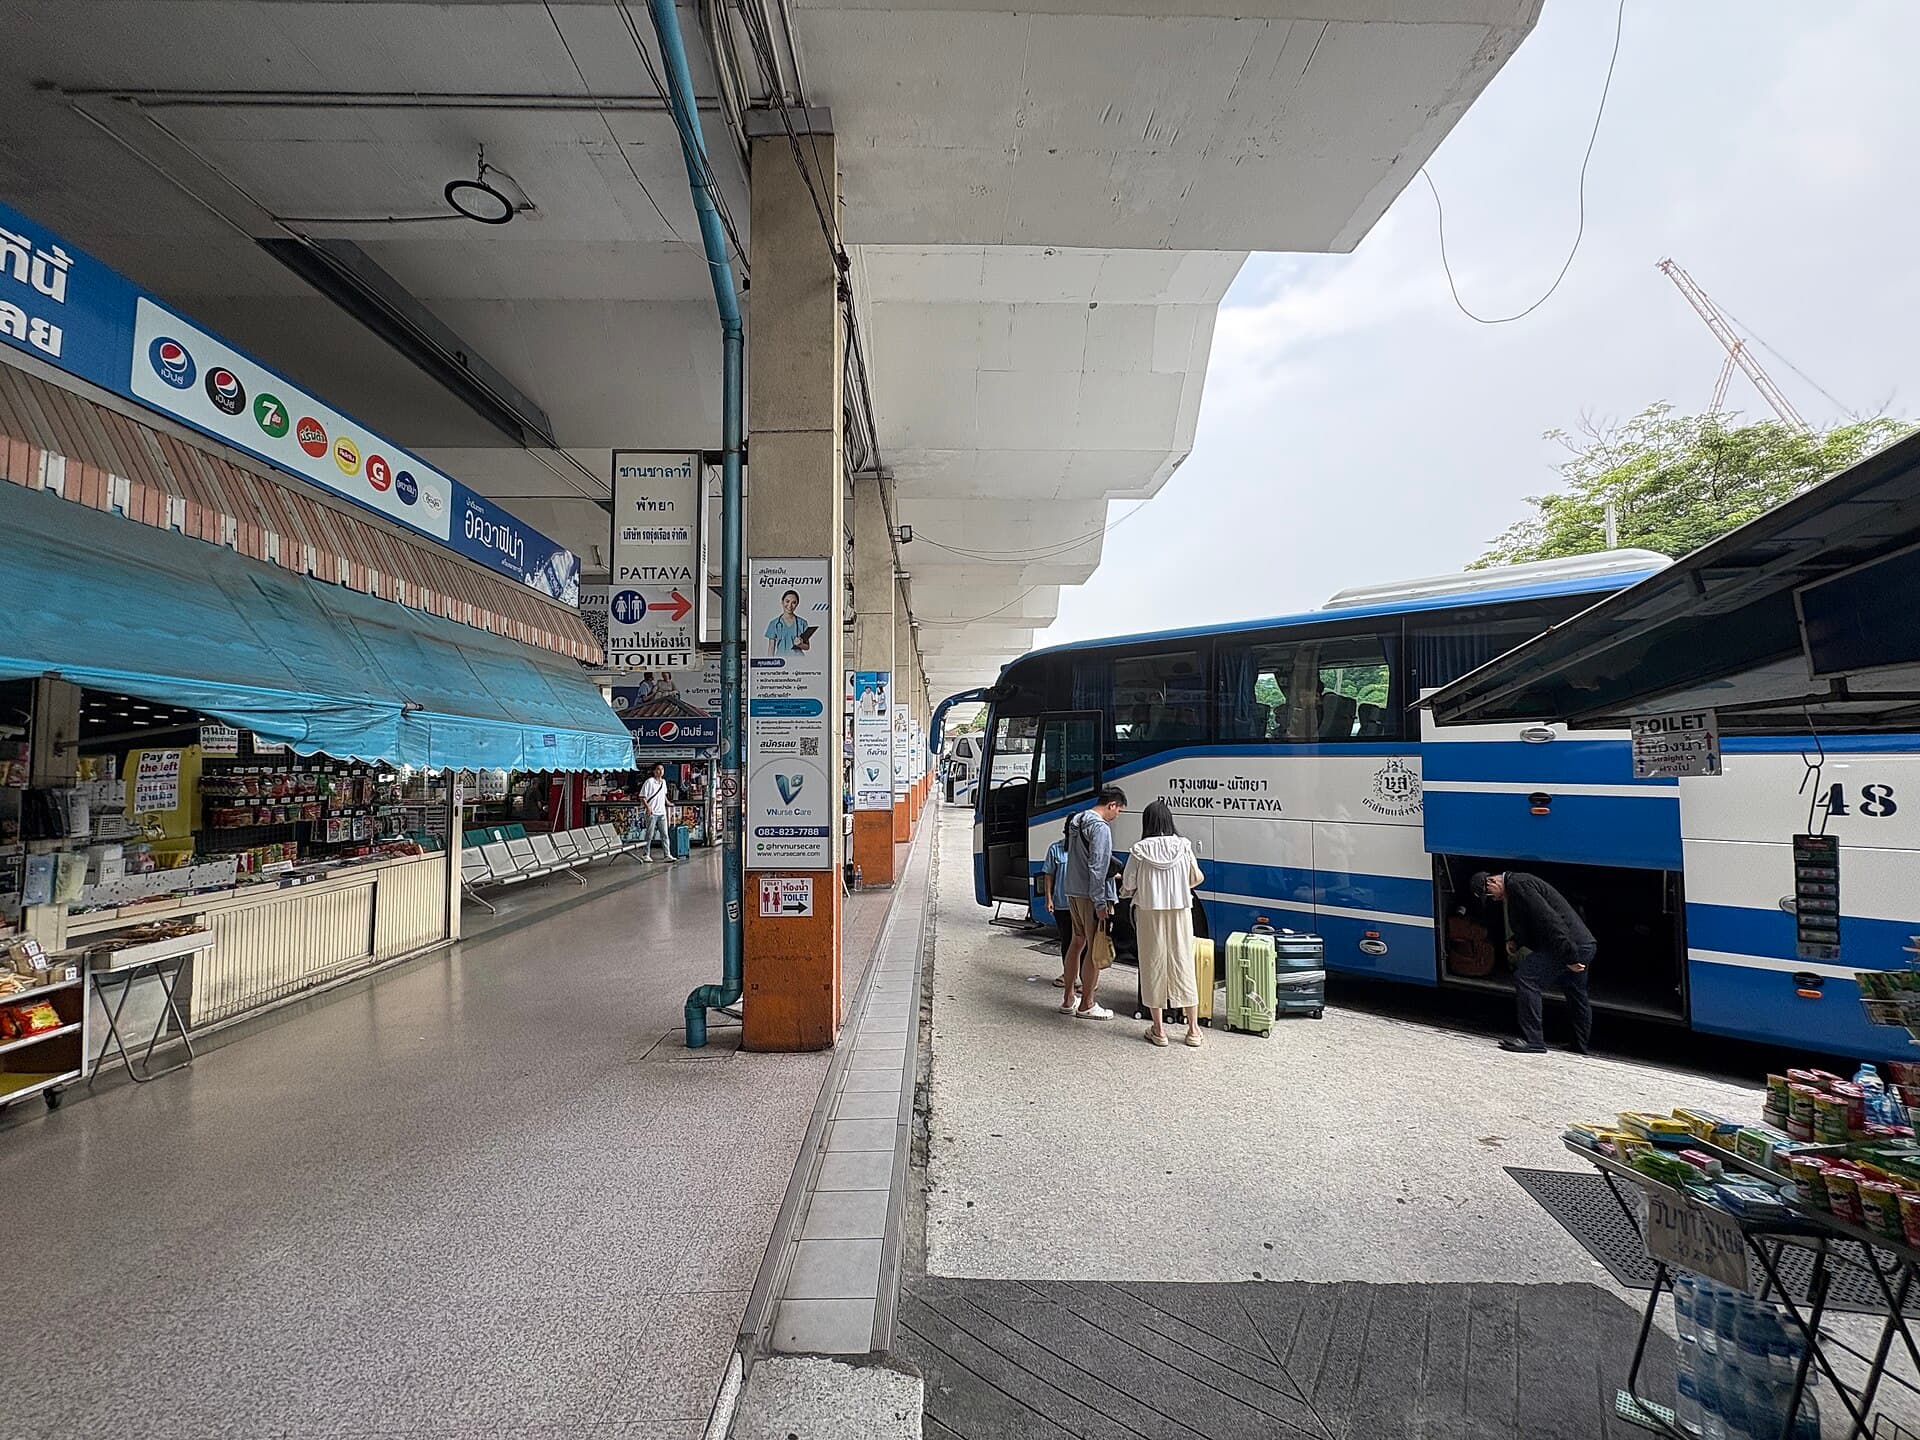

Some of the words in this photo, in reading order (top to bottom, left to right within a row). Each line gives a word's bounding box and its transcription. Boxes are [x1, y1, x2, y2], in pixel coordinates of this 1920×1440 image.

[372, 462, 385, 480] G
[619, 457, 691, 478] ชานชาลาที่
[636, 496, 674, 511] พัทยา
[620, 567, 692, 580] PATTAYA
[611, 627, 691, 648] ทางไปห้องน้ำ
[611, 653, 692, 666] TOILET
[1636, 713, 1706, 733] TOILET
[681, 725, 702, 737] เป๊ปซี่
[142, 753, 163, 762] Pay
[141, 763, 158, 772] the
[160, 762, 177, 771] left
[1816, 783, 1898, 818] 48
[758, 828, 819, 836] 082-823-7788
